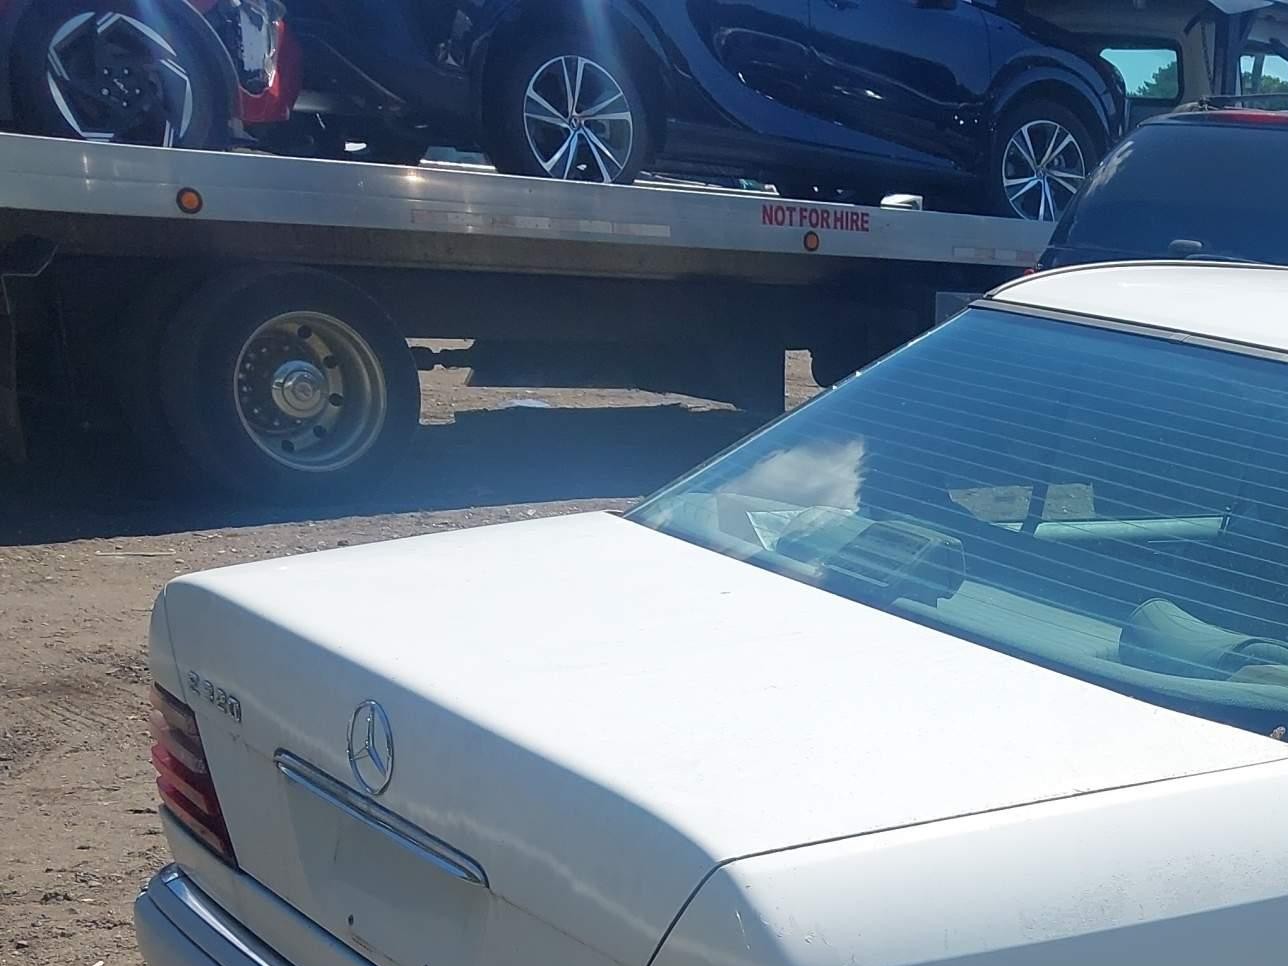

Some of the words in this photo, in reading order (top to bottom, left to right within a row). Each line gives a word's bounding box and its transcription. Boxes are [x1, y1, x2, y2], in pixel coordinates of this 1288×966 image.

[762, 204, 796, 227] NOT
[800, 207, 830, 229] FOR
[834, 209, 870, 232] HIRE
